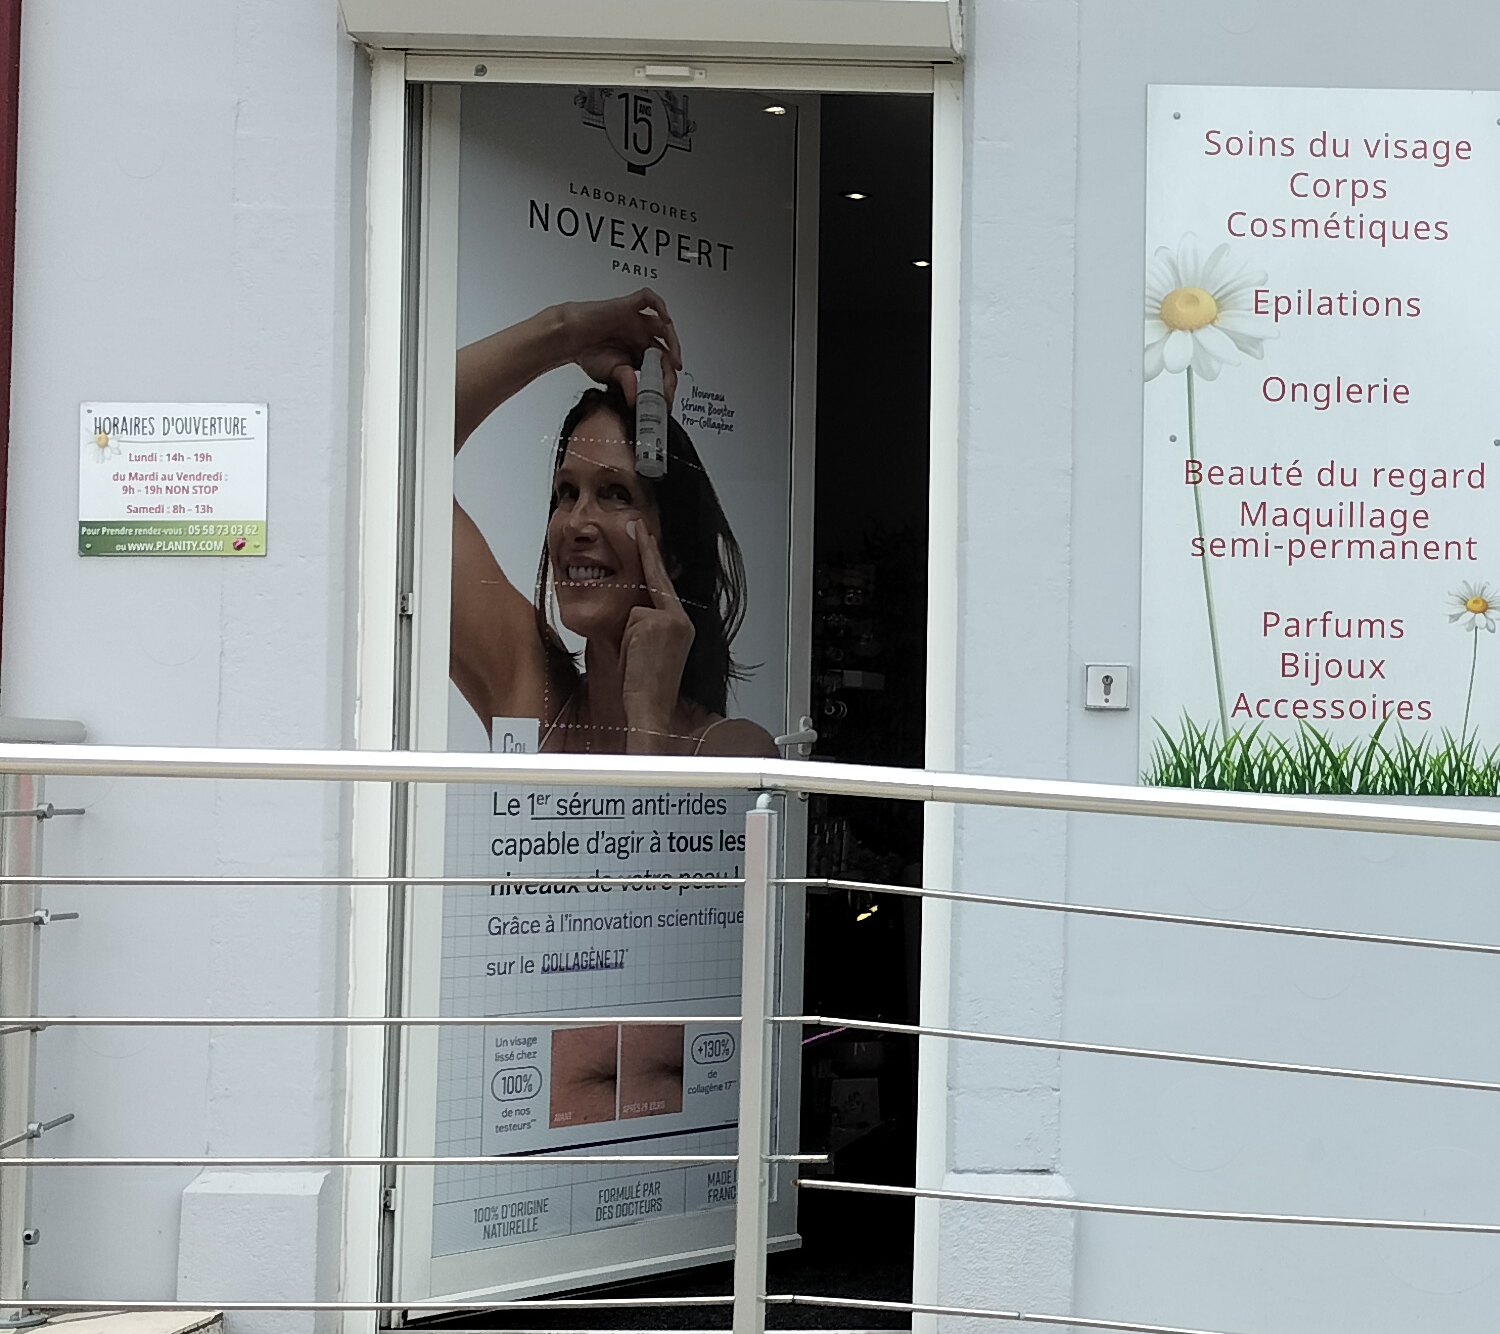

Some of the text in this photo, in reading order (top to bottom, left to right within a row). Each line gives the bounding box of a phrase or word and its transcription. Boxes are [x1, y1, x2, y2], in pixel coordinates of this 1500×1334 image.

[618, 93, 652, 155] 15
[1204, 130, 1473, 168] Soins du visage
[570, 182, 698, 223] LABORATOIRES
[1289, 172, 1388, 207] Corps
[529, 199, 734, 272] NOVEXPERT
[1227, 211, 1450, 247] Cosmétiques
[612, 260, 658, 279] PARIS
[1253, 289, 1422, 323] Epilations
[1262, 376, 1410, 411] Onglerie
[93, 416, 248, 436] HORAIRES D'OUVERTURE
[128, 452, 158, 462] Lundi
[166, 452, 185, 462] 14h
[194, 452, 213, 462] 19h
[112, 472, 126, 481] du
[129, 472, 158, 481] Mardi
[161, 473, 174, 481] au
[175, 472, 223, 481] Vendredi
[1185, 459, 1485, 496] Beauté du regard
[122, 485, 219, 495] 9h 19h NON STOP
[126, 504, 164, 514] Samedi
[172, 504, 185, 514] 8h
[195, 504, 213, 514] 13h
[1240, 501, 1430, 536] Maquillage
[81, 526, 100, 535] Pour
[102, 526, 133, 536] Prendre
[188, 525, 199, 535] 05
[216, 525, 229, 535] 73
[127, 540, 224, 551] WWW.PLANITY.COM
[1190, 531, 1478, 566] semi-permanent
[1262, 611, 1405, 639] Parfums
[1281, 652, 1386, 686] Bijoux
[1231, 692, 1433, 720] Accessoires
[493, 792, 727, 816] Le 1er sérum anti-rides
[491, 828, 746, 862] capable d'agir à tous les
[488, 907, 744, 936] Grâce à l'innovation scientifique
[486, 958, 516, 976] sur
[520, 956, 535, 974] le
[541, 947, 611, 973] COLLAGÈNE
[495, 1035, 538, 1048] Un visage
[501, 1073, 533, 1095] 100%
[707, 1070, 718, 1079] de
[501, 1107, 531, 1118] de nos
[707, 1169, 731, 1187] MADE
[598, 1180, 661, 1205] FORMULÉ PAR
[707, 1186, 737, 1204] FRANC
[473, 1197, 550, 1224] 100% D'ORIGINE
[595, 1197, 663, 1222] DES DOCTEURS
[483, 1216, 538, 1240] NATURELLE
